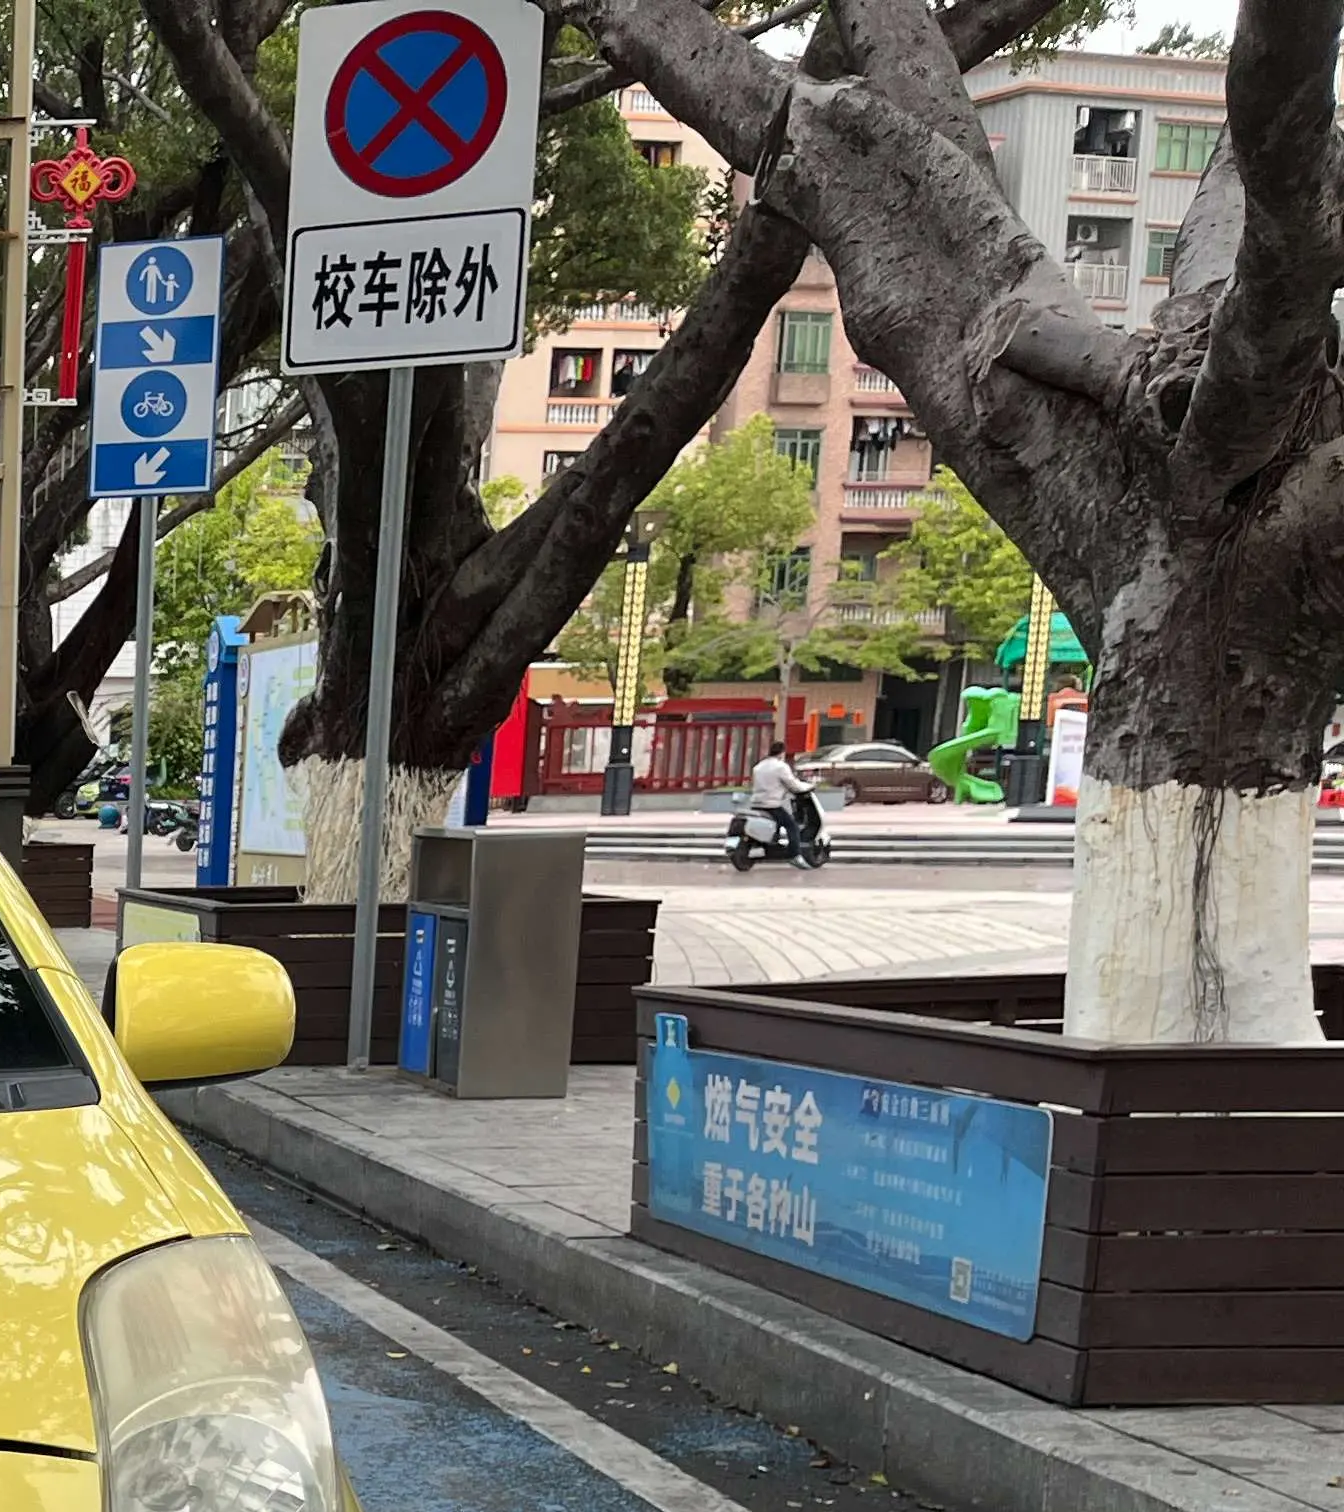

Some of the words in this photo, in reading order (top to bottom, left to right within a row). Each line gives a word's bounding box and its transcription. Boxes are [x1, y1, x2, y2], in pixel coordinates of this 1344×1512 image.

[70, 170, 92, 192] 福
[312, 243, 499, 330] 校车除外
[703, 1073, 824, 1166] 燃气安全
